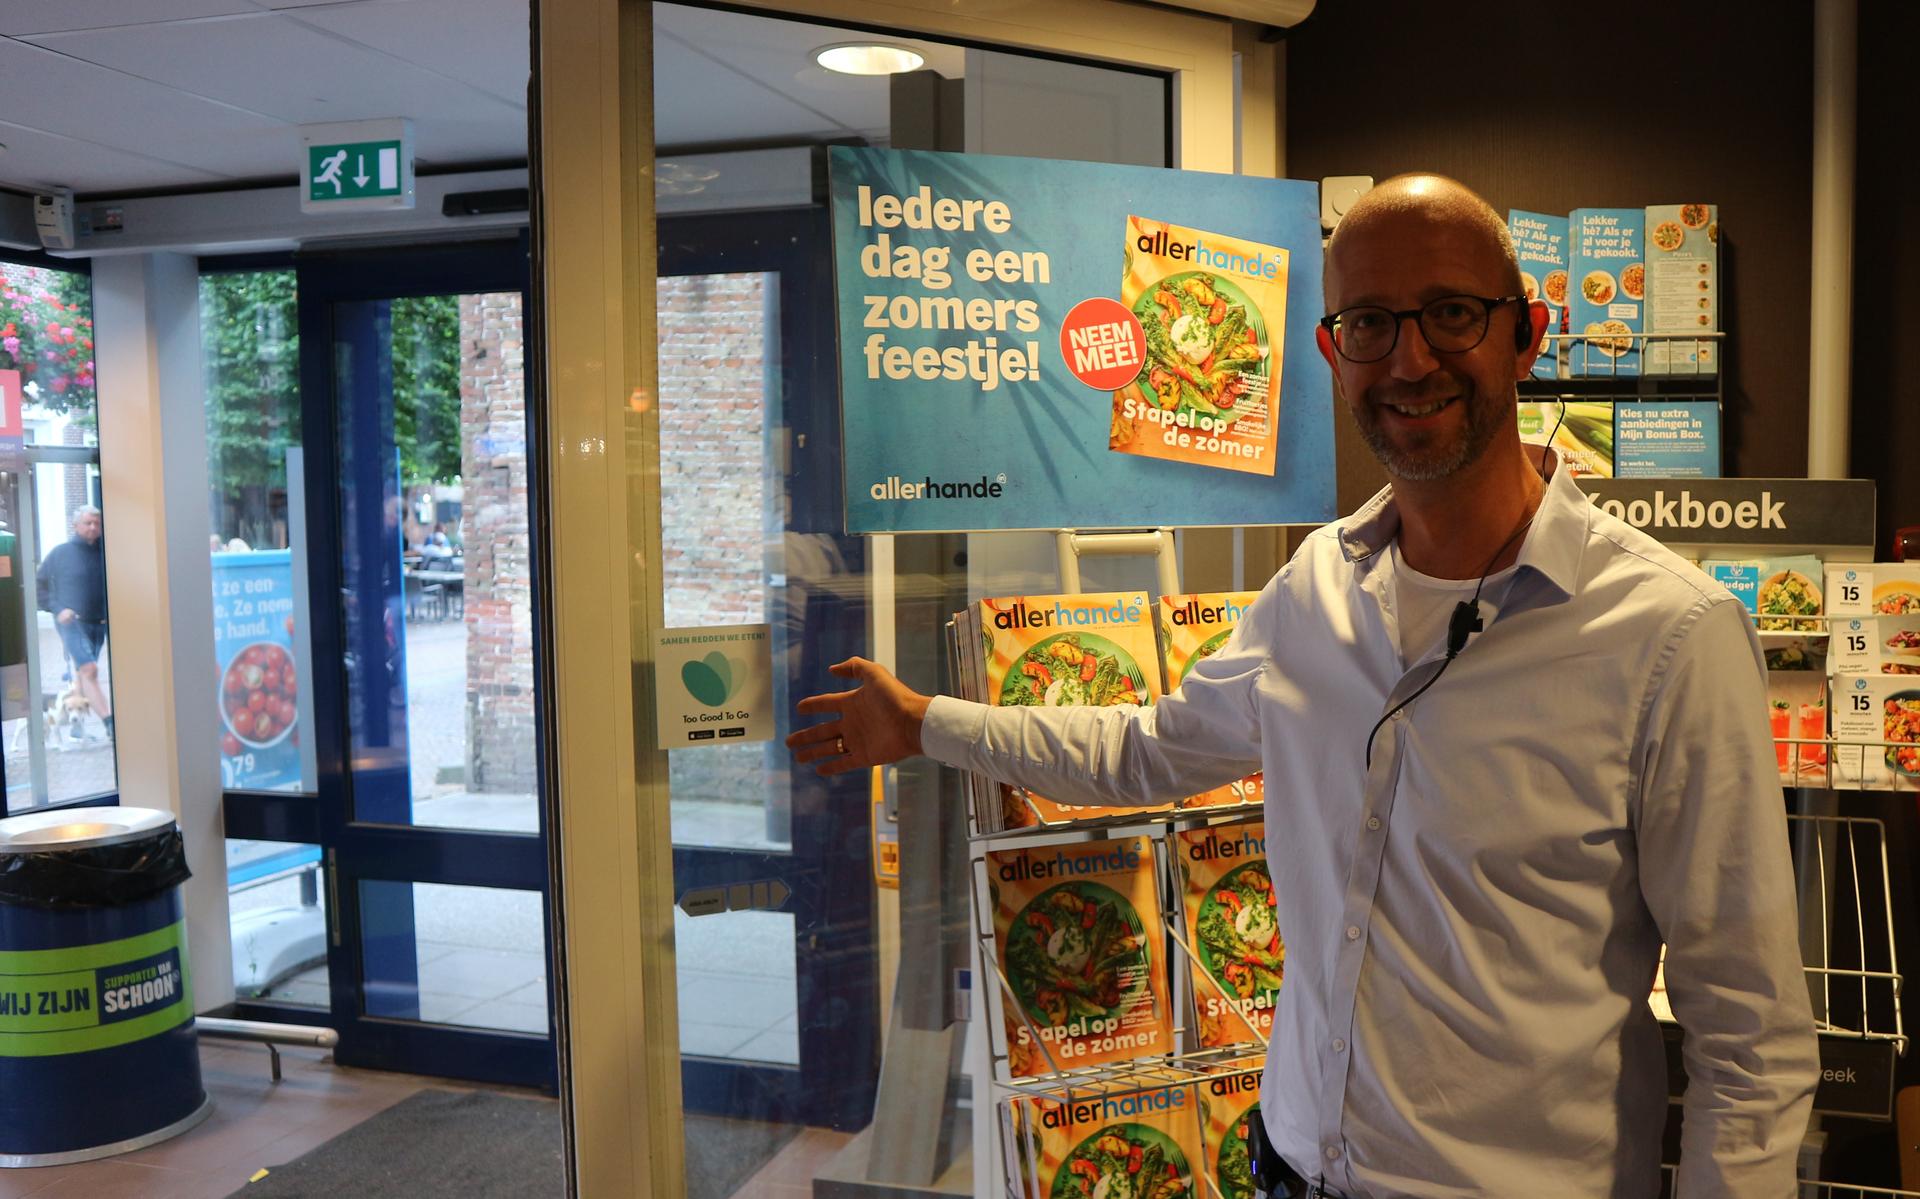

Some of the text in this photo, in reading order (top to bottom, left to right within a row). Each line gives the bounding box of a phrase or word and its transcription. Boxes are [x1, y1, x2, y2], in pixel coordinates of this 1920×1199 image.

[858, 185, 1012, 233] Iedere
[1583, 215, 1618, 226] Lekker
[1603, 226, 1620, 237] Als
[1622, 229, 1634, 237] er
[1523, 241, 1546, 251] voor
[1547, 243, 1557, 254] je
[1532, 231, 1548, 242] Als
[1583, 237, 1631, 249] al voor je
[861, 233, 1050, 290] dag een
[1137, 231, 1277, 279] allerhande
[1582, 247, 1639, 259] is gekookt.
[863, 295, 1040, 332] zomers
[1069, 320, 1134, 349] NEEM
[863, 334, 1040, 391] feestje!
[1073, 340, 1139, 374] MEE!
[1123, 398, 1228, 438] Stapel op
[1620, 408, 1689, 418] Kies nu extra
[1620, 419, 1702, 430] aanbiedingen in
[1620, 429, 1704, 441] Mijn Bonus Box.
[1163, 425, 1265, 460] de zomer
[870, 475, 1003, 500] allerhande
[222, 578, 274, 596] ze een
[1841, 586, 1860, 601] 15
[233, 599, 253, 617] Ze
[994, 599, 1141, 630] allerhande
[1847, 635, 1866, 652] 15
[1851, 695, 1871, 711] 15
[683, 710, 749, 724] Too Good To Go
[1001, 846, 1140, 883] allerhande
[37, 987, 91, 1016] ZIJN
[104, 974, 175, 1014] SCHOON
[1091, 1017, 1119, 1037] op
[1059, 1030, 1158, 1059] de zomer
[1042, 1087, 1185, 1129] allerhande
